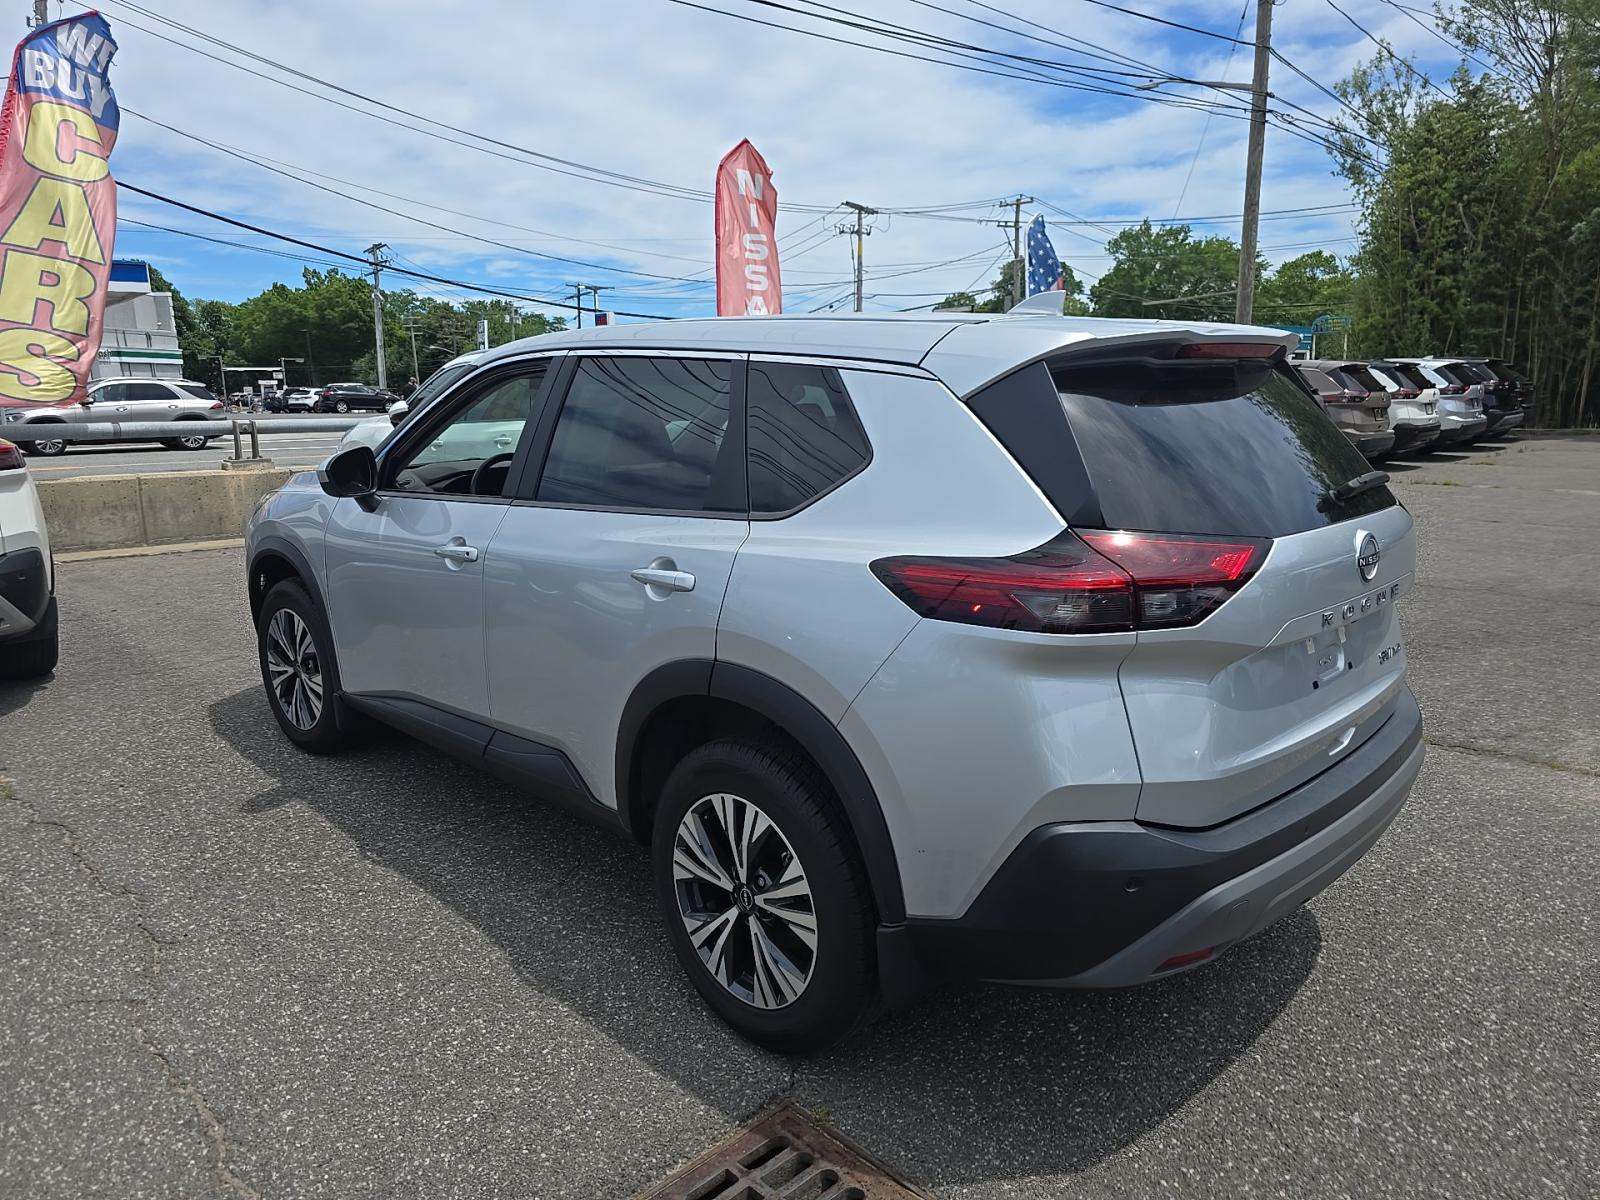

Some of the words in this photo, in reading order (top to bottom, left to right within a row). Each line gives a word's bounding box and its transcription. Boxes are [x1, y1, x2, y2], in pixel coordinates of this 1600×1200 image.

[24, 49, 111, 119] BUY
[0, 100, 110, 402] CARS
[1359, 553, 1379, 567] NISS
